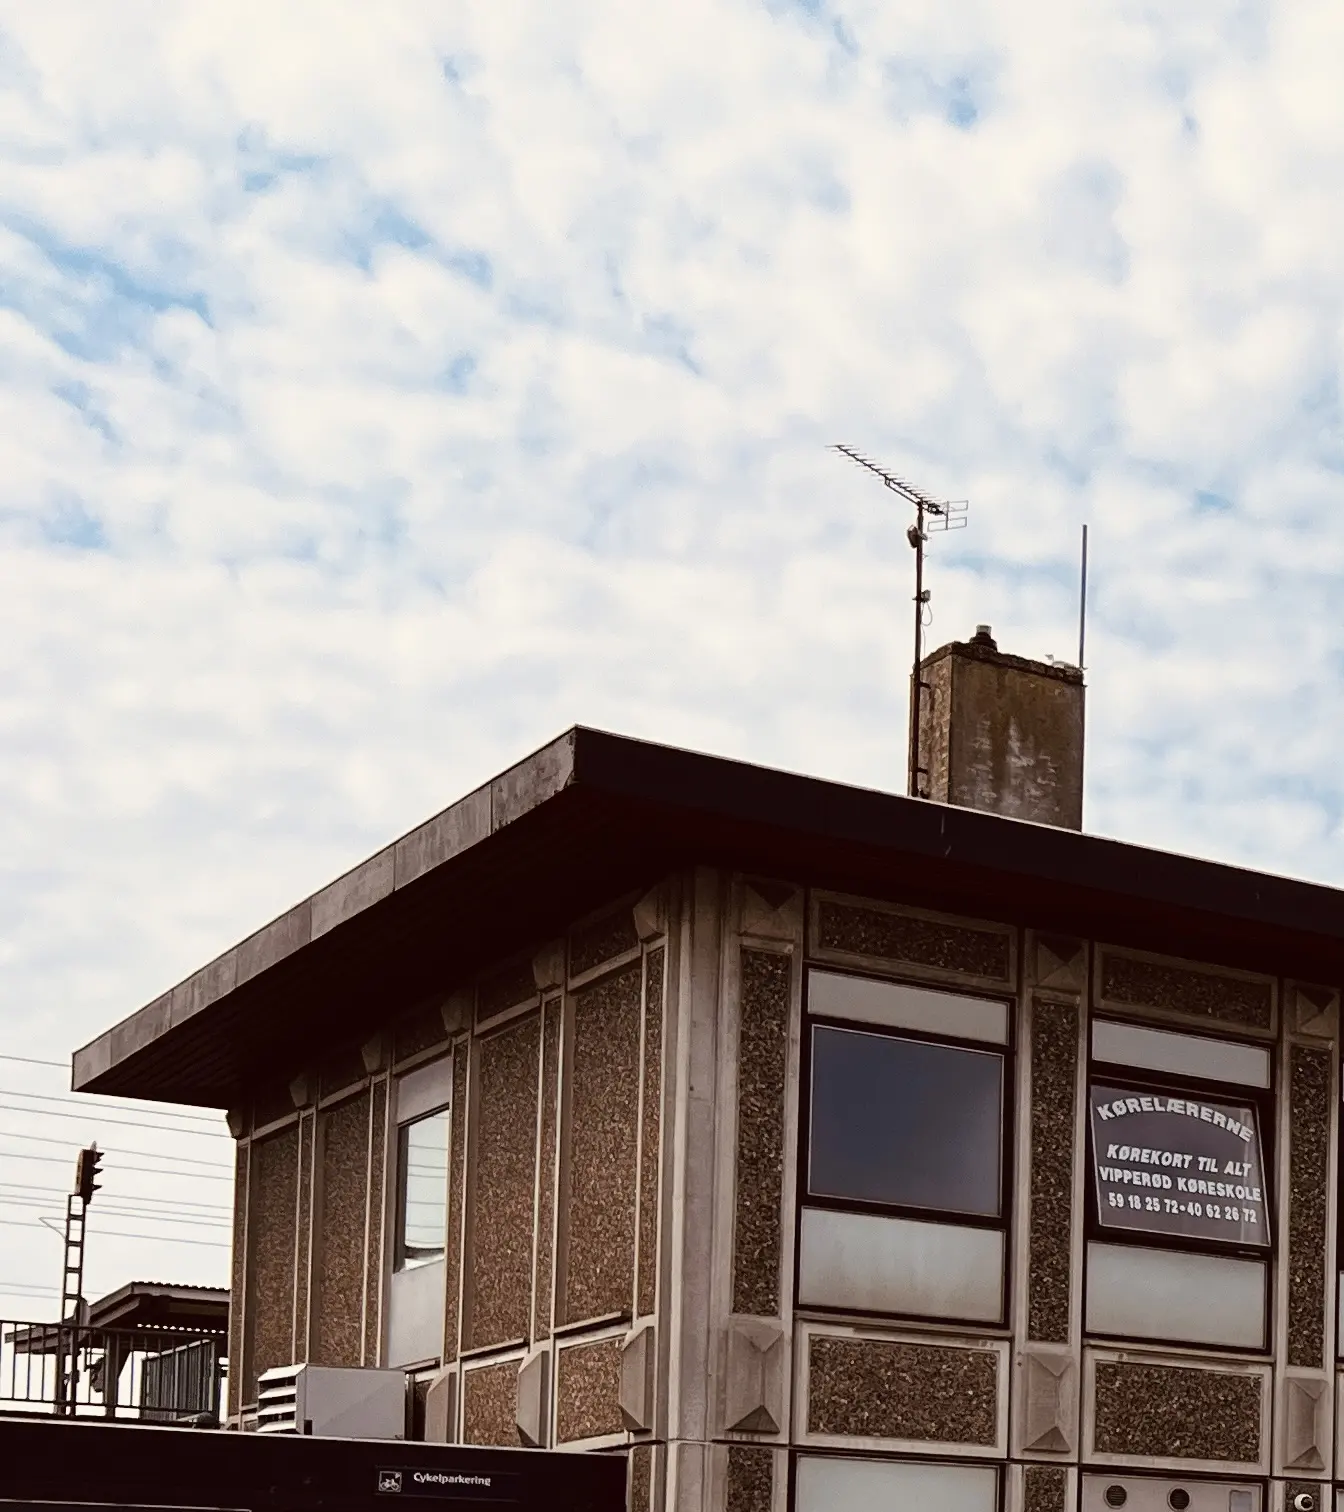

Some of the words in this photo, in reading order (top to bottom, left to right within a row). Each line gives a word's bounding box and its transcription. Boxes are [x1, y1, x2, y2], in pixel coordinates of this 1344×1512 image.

[1096, 1097, 1254, 1142] KØRELÆRERNE
[1107, 1144, 1193, 1169] KØREKORT
[1198, 1156, 1219, 1173] TIL
[1223, 1161, 1252, 1177] ALT
[1099, 1166, 1172, 1190] VIPPERØD
[1177, 1177, 1262, 1202] KØRESKOLE
[1108, 1192, 1124, 1208] 59
[1128, 1194, 1142, 1210] 18
[1145, 1197, 1161, 1212] 25
[1206, 1203, 1221, 1219] 62
[1224, 1206, 1239, 1222] 26
[1242, 1208, 1257, 1223] 72
[413, 1472, 491, 1487] Cykelparkering
